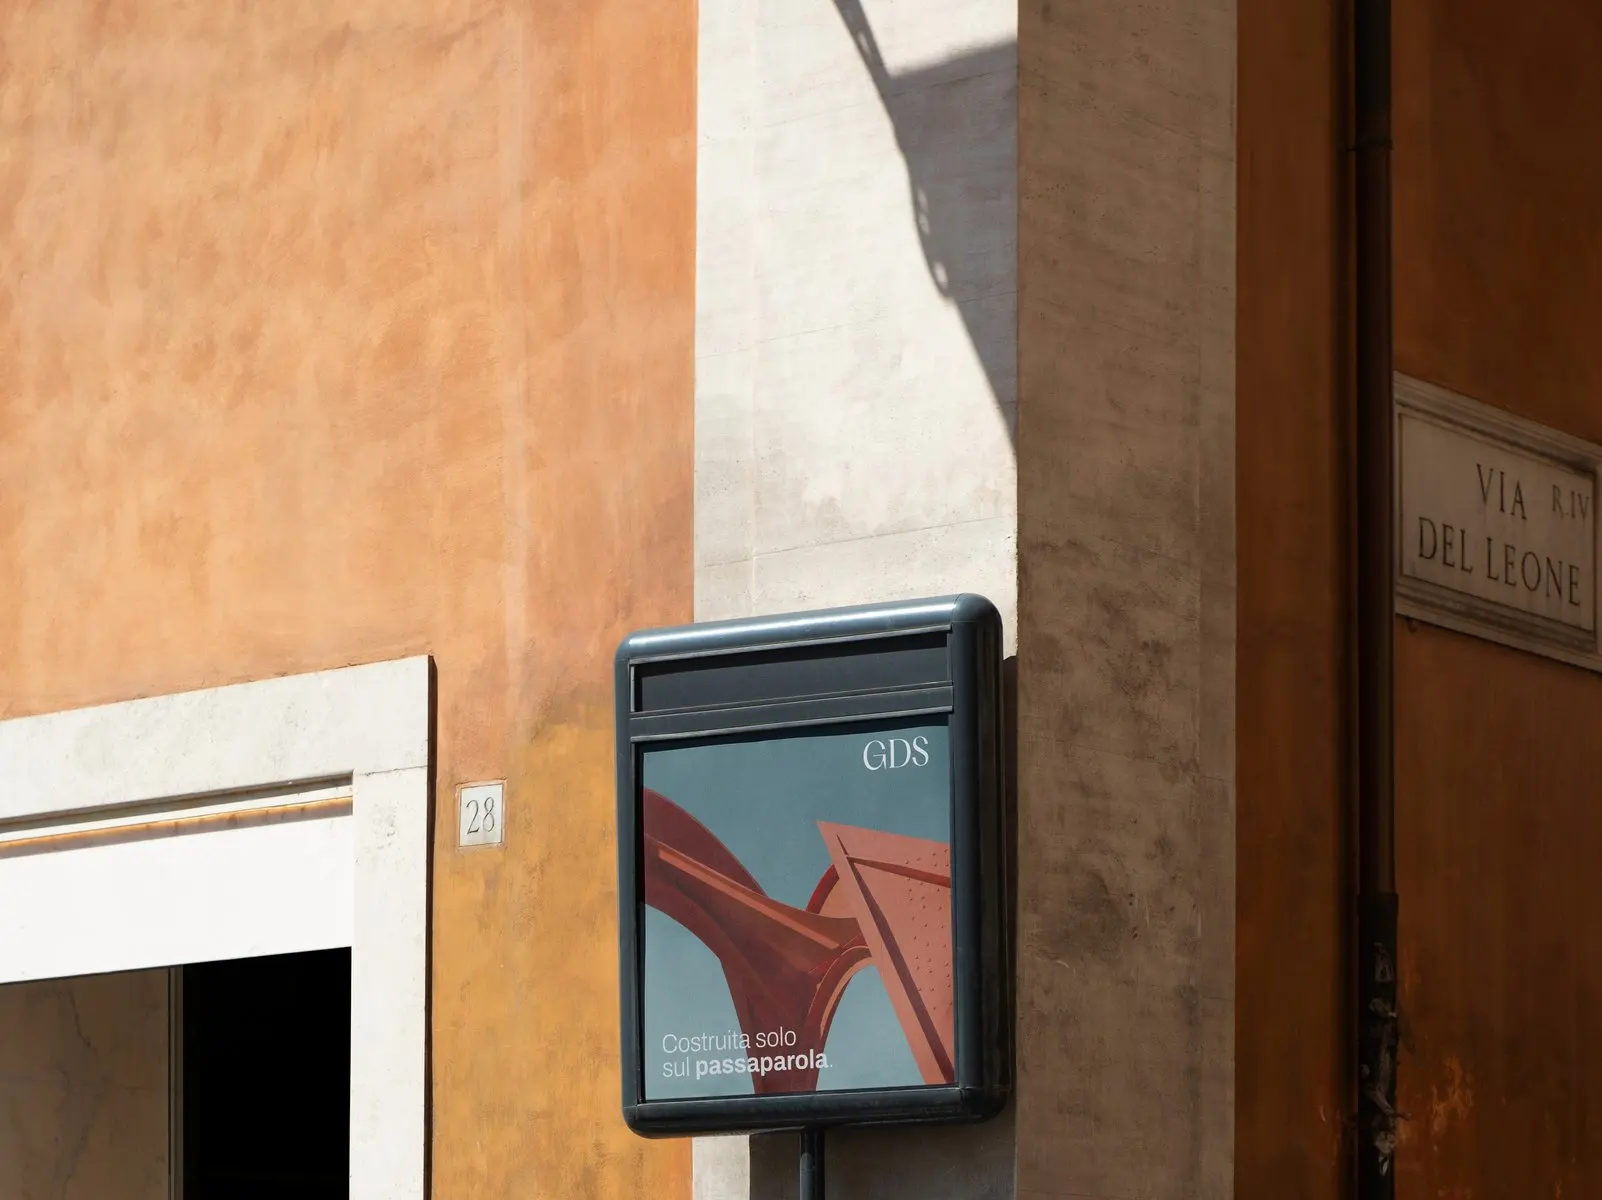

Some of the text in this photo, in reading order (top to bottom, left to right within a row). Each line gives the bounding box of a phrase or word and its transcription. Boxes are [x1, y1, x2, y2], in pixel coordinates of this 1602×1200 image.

[1476, 462, 1528, 520] VIA
[1417, 516, 1581, 607] DEL LEONE
[862, 735, 930, 771] GDS
[465, 796, 496, 835] 28
[662, 1026, 797, 1054] Costruita solo
[662, 1048, 834, 1080] sul passaparola.
